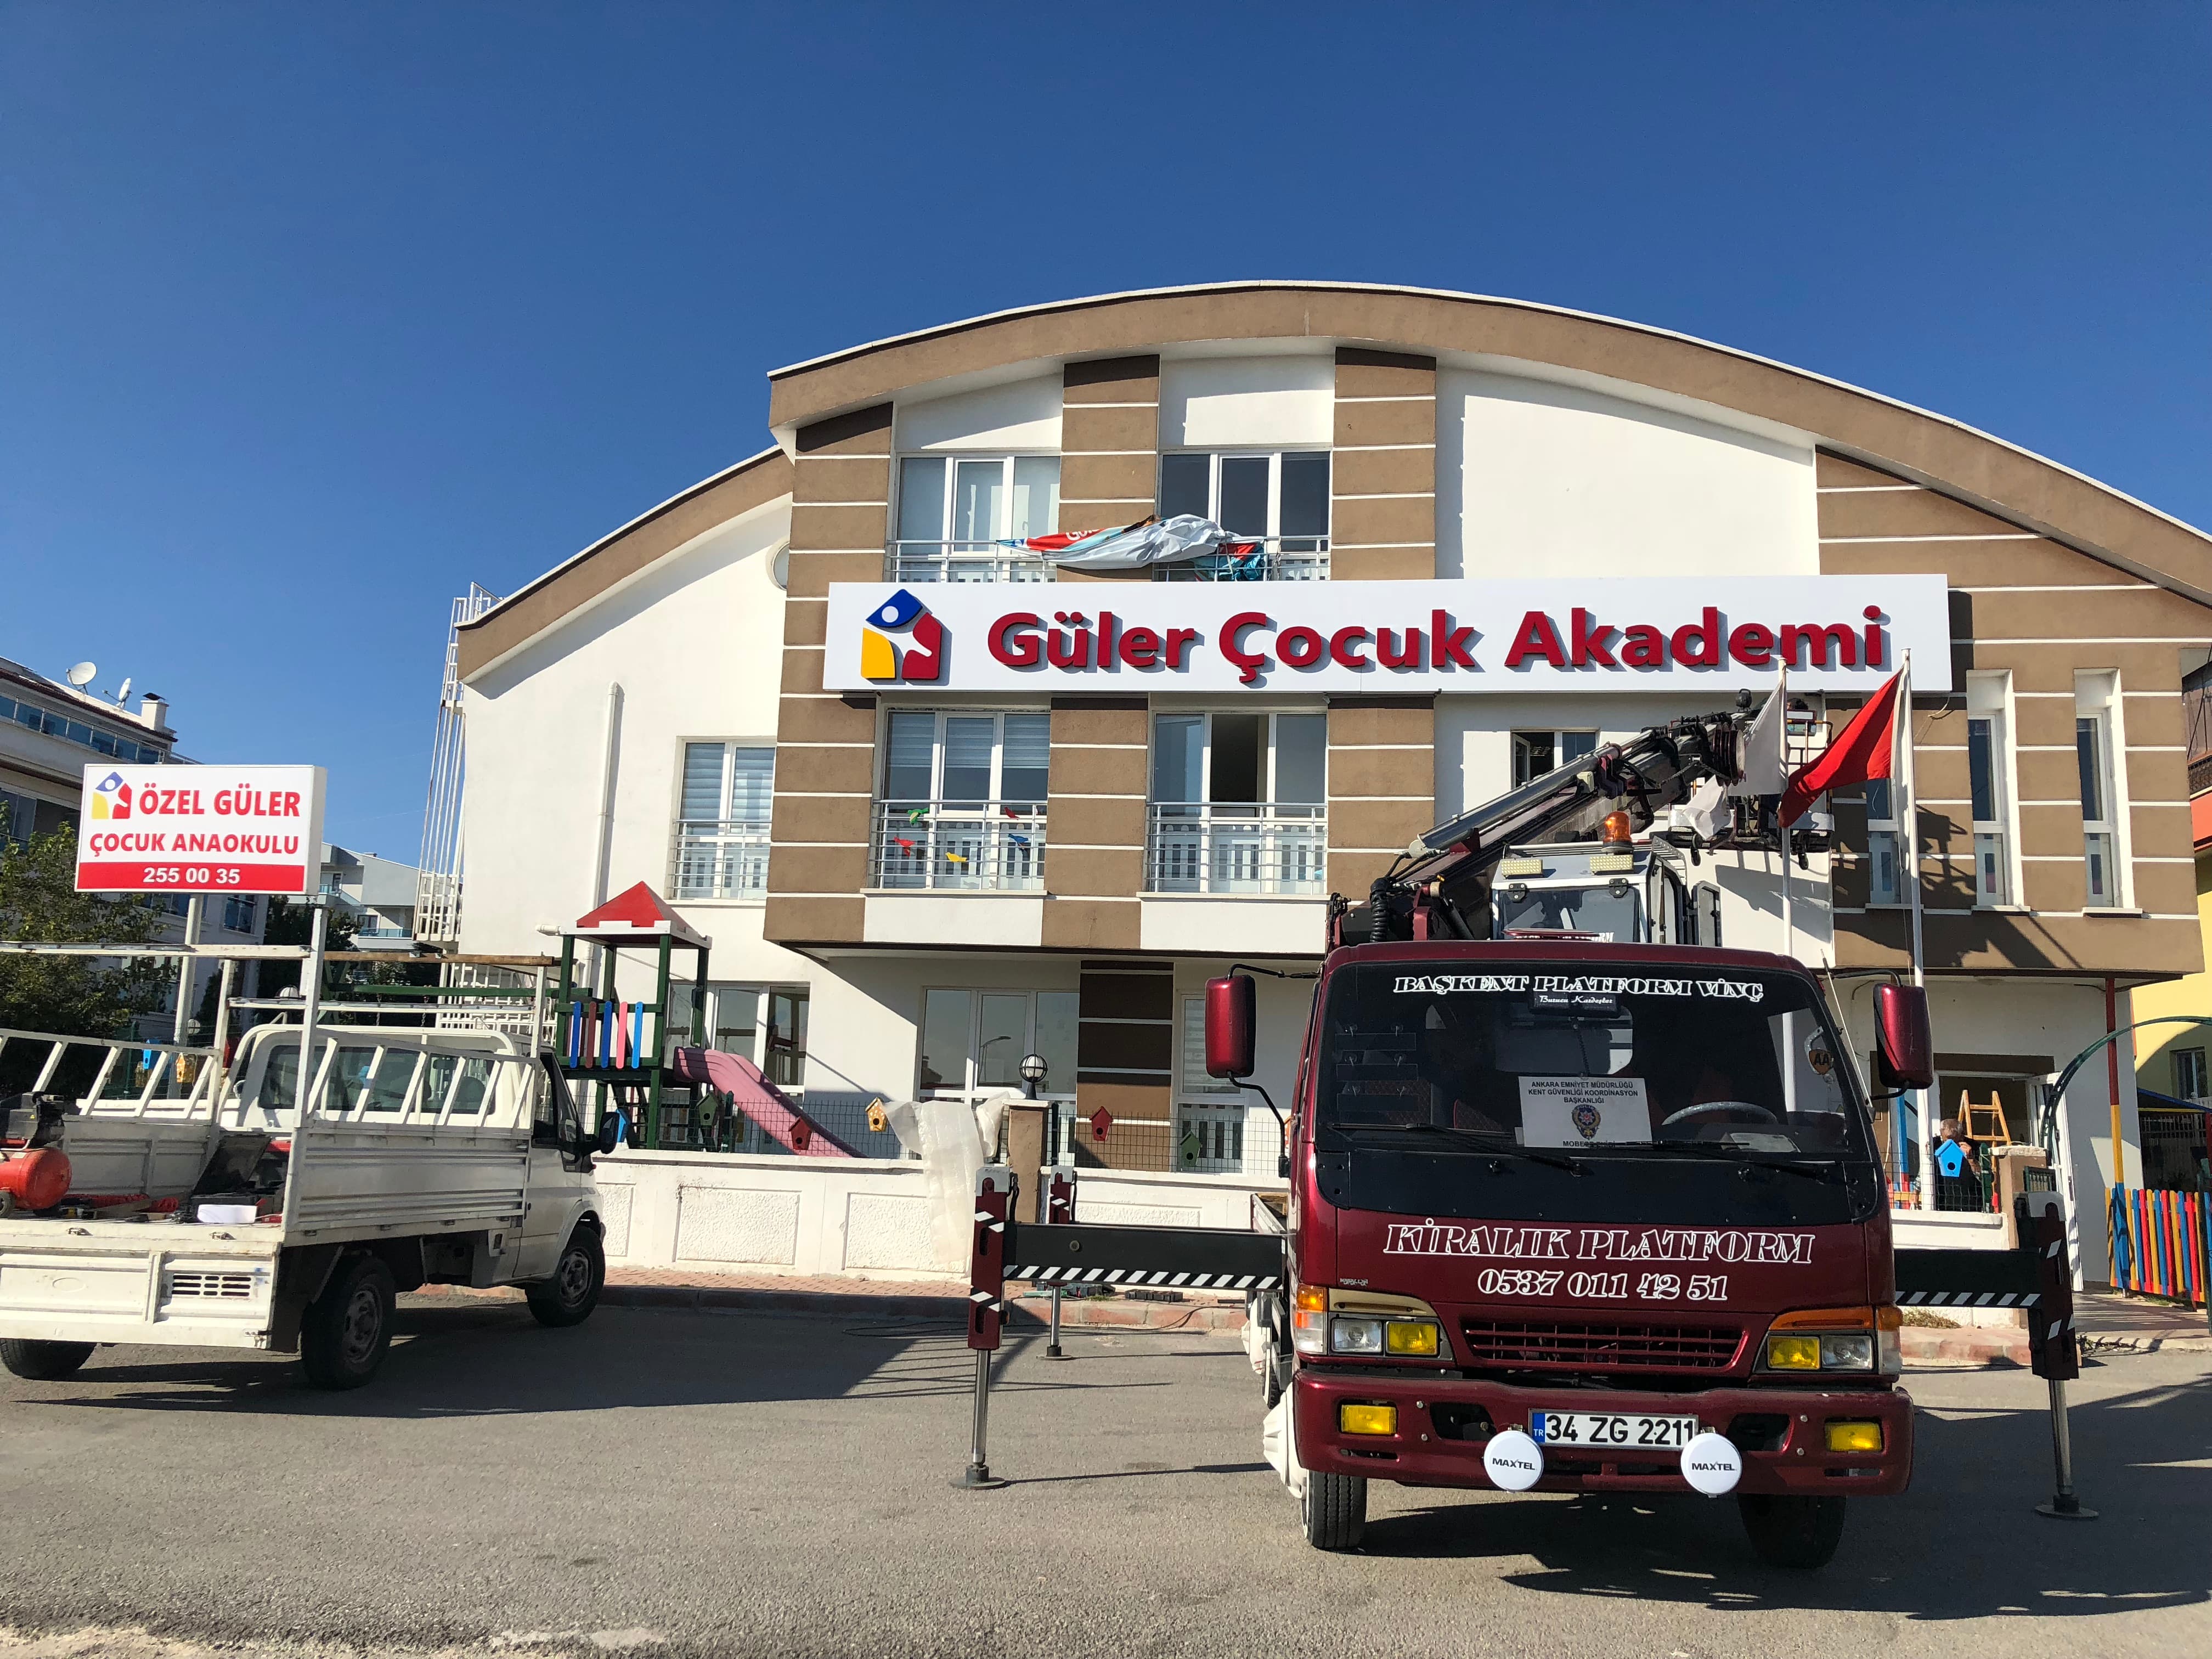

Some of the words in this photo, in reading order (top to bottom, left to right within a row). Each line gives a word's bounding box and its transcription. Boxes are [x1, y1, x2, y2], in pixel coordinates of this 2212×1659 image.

[988, 611, 1194, 668] Güler
[1219, 610, 1474, 682] Çocuk
[1504, 605, 1881, 666] Akademi
[139, 782, 205, 815] ÖZEL
[214, 783, 301, 817] GÜLER
[90, 833, 165, 856] ÇOCUK
[172, 834, 298, 854] ANAOKULU
[143, 867, 180, 883] 255
[185, 867, 210, 883] 00
[216, 868, 240, 884] 35
[1393, 975, 1530, 995] BAŞKENT
[1533, 976, 1692, 996] PLATFORM
[1695, 978, 1764, 1002] VİNÇ
[1383, 1217, 1572, 1259] KİRALIK
[1576, 1229, 1815, 1264] PLATFORM
[1477, 1268, 1565, 1296] 0537
[1567, 1272, 1628, 1298] 011
[1636, 1273, 1681, 1300] 42
[1686, 1274, 1728, 1301] 51
[1533, 1428, 1544, 1437] TR
[1546, 1415, 1578, 1441] 34
[1589, 1417, 1628, 1443] ZG
[1638, 1419, 1693, 1446] 2211
[1492, 1458, 1536, 1470] MAXTEL
[1691, 1461, 1735, 1471] MAXTEL
